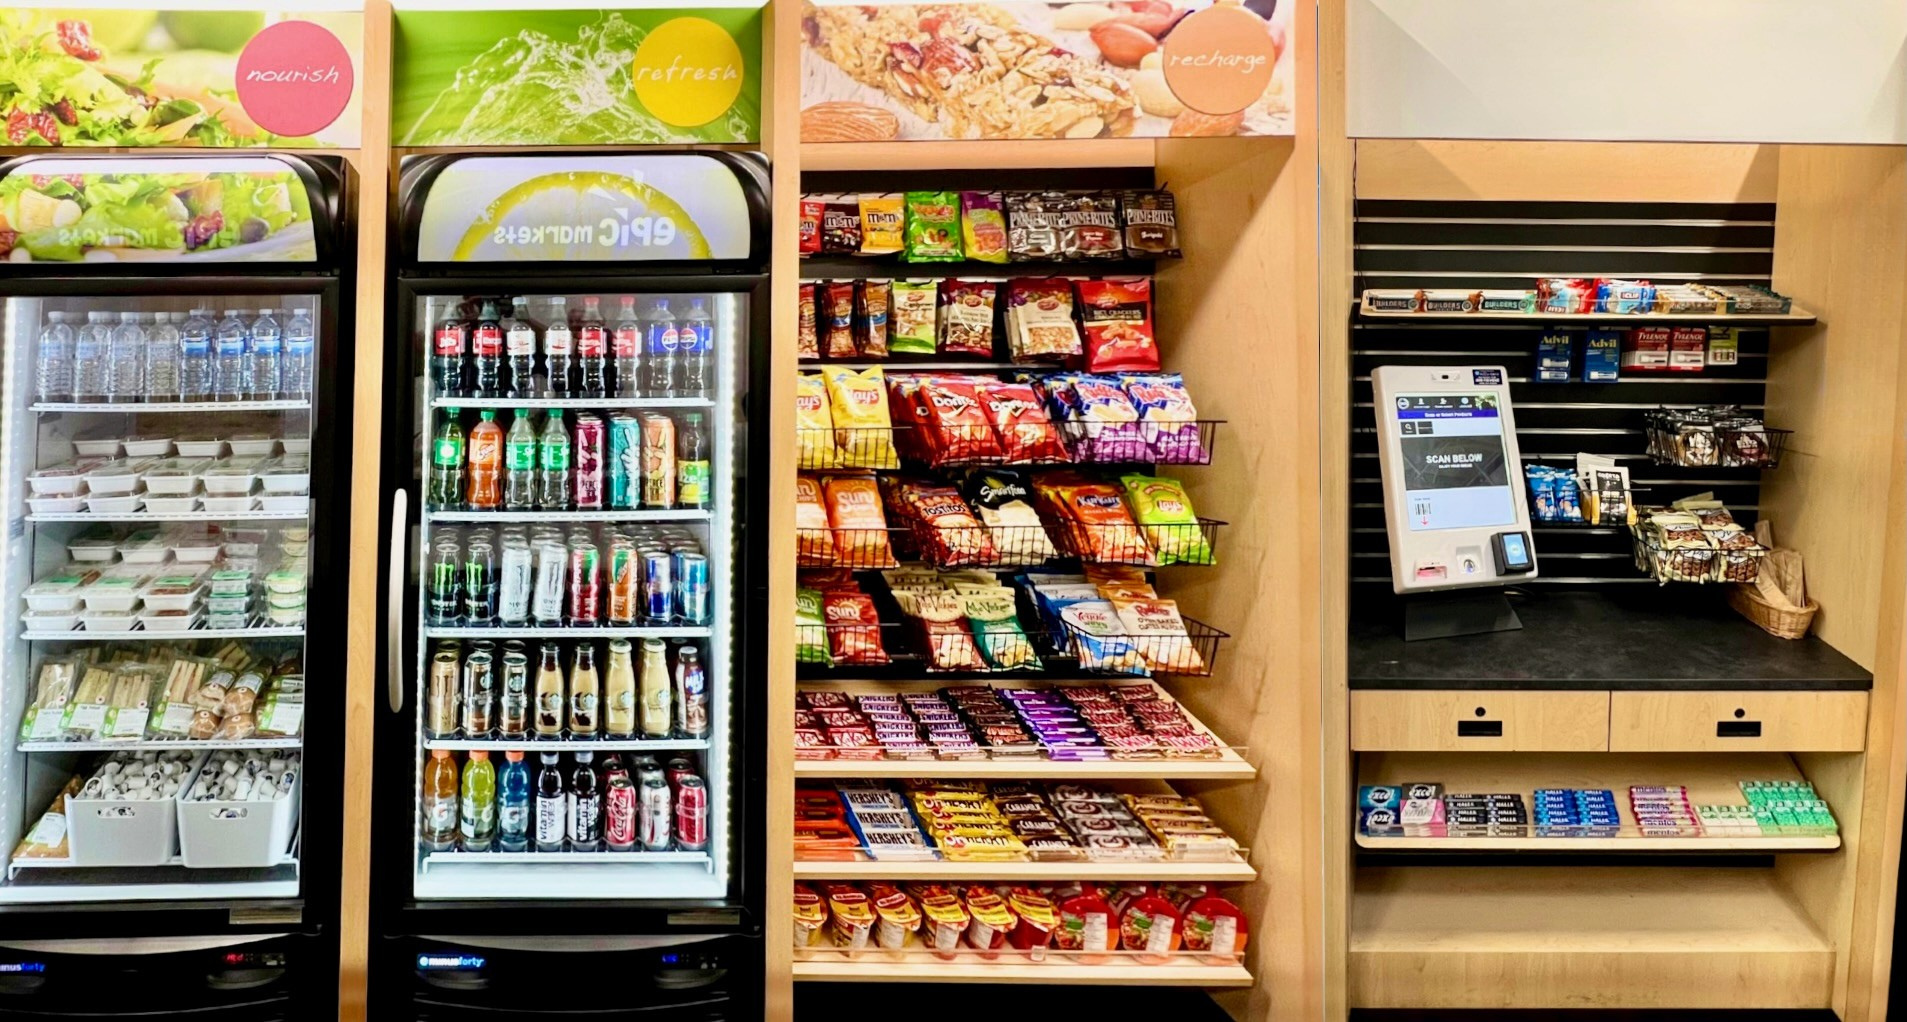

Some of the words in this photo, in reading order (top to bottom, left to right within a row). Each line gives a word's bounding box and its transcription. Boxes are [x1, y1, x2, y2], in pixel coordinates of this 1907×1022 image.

[637, 54, 738, 83] refresh
[1168, 49, 1266, 75] recharge
[246, 65, 339, 85] nourish
[1484, 300, 1518, 308] BUILDERS
[1541, 334, 1569, 345] Advil
[1588, 338, 1617, 348] Advil
[1425, 454, 1451, 464] SCAN
[1452, 453, 1483, 463] BELOW
[826, 605, 861, 621] Sun
[848, 791, 893, 804] HERSHEY'S
[540, 799, 548, 840] vitamin
[578, 798, 588, 841] vitamin
[858, 811, 905, 825] HERSHEY'S
[867, 832, 915, 846] HERSHEY'S
